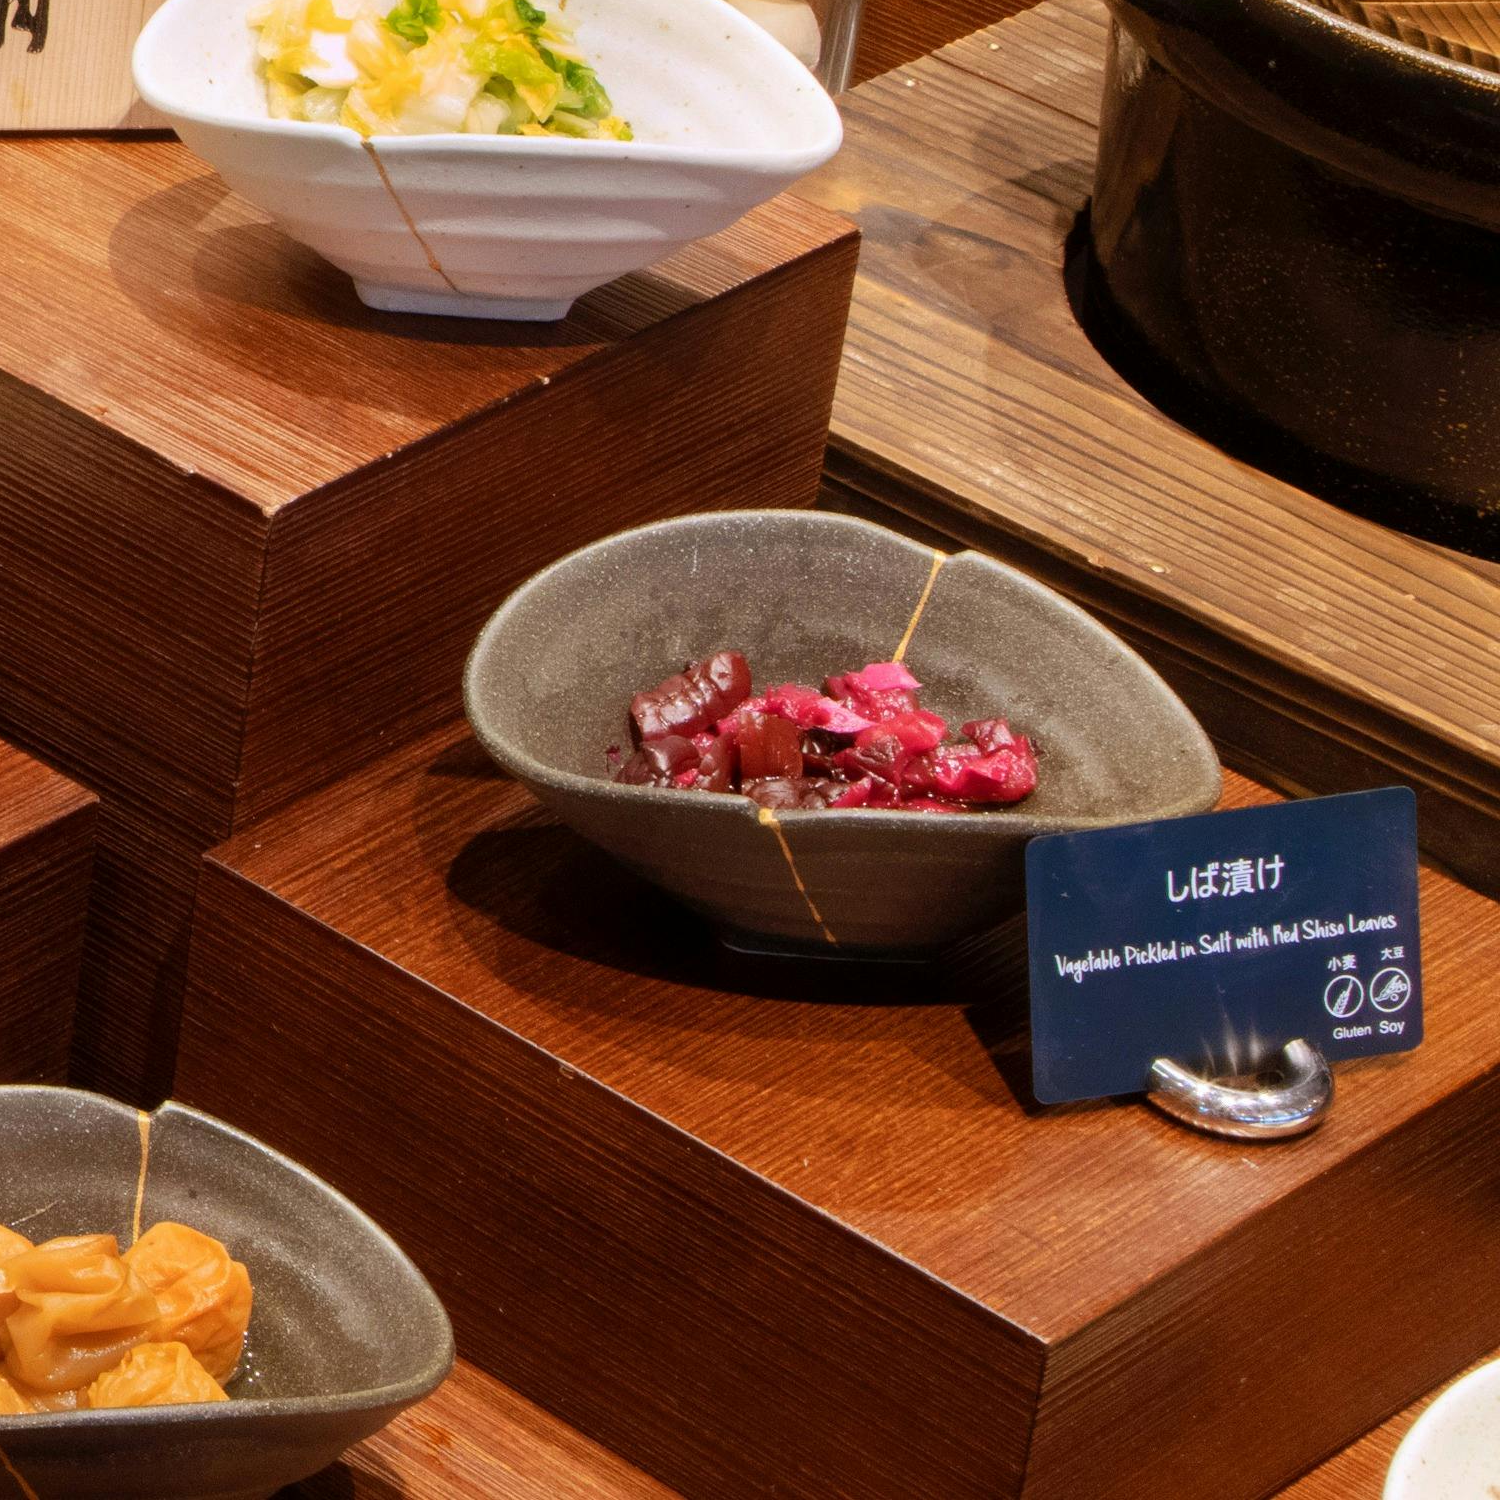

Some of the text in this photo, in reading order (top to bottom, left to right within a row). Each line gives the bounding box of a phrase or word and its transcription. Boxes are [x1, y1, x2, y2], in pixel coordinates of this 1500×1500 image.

[1168, 855, 1284, 902] しば漬け
[1124, 941, 1177, 965] Pickled
[1181, 942, 1196, 958] in
[1199, 931, 1231, 954] Salt
[1236, 927, 1269, 949] with
[1273, 923, 1299, 944] Red
[1302, 920, 1344, 939] Shiso
[1349, 914, 1397, 933] Leaves
[1381, 946, 1404, 960] 大豆
[1328, 954, 1356, 971] 小麦
[1332, 1023, 1373, 1041] Gluten
[1378, 1019, 1406, 1036] Soy
